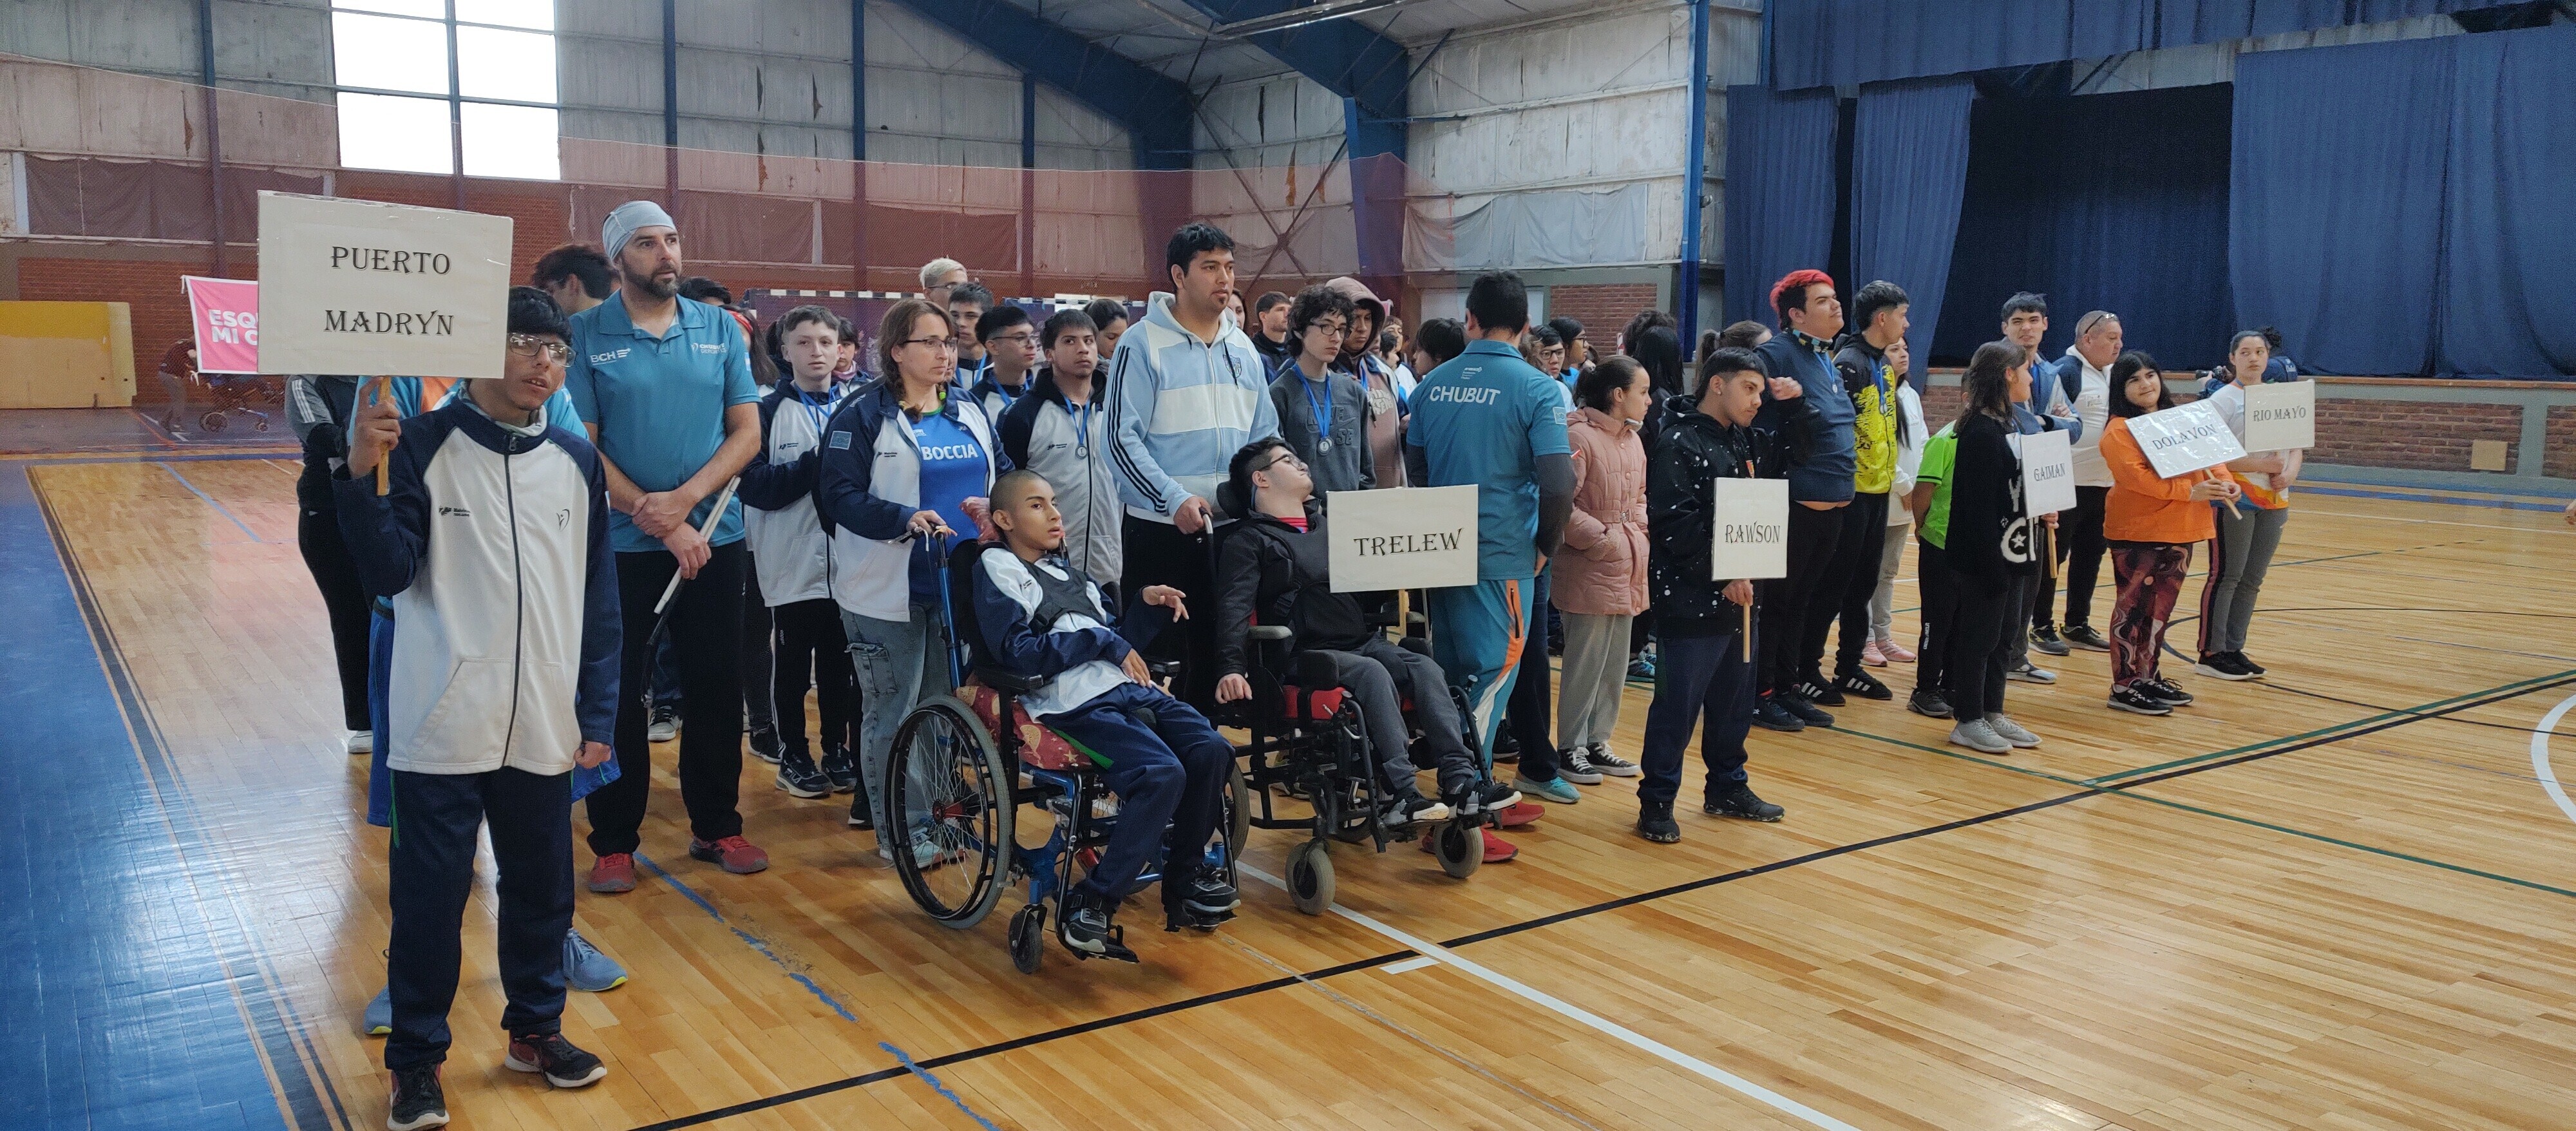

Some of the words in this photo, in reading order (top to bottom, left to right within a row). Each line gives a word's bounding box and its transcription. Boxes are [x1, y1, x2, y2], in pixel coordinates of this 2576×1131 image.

[330, 246, 451, 275] PUERTO
[208, 309, 258, 328] ESQ
[323, 309, 454, 336] MADRYN
[211, 326, 240, 344] MI
[590, 350, 616, 363] BCH
[1430, 386, 1501, 405] CHUBUT
[2253, 409, 2271, 422] RIO
[2274, 405, 2306, 420] MAYO
[2152, 424, 2219, 450] DOLAVON
[921, 444, 979, 461] BOCCIA
[2034, 462, 2065, 481] GAIMAN
[1353, 527, 1464, 556] TRELEW
[1725, 520, 1781, 544] RAWSON
